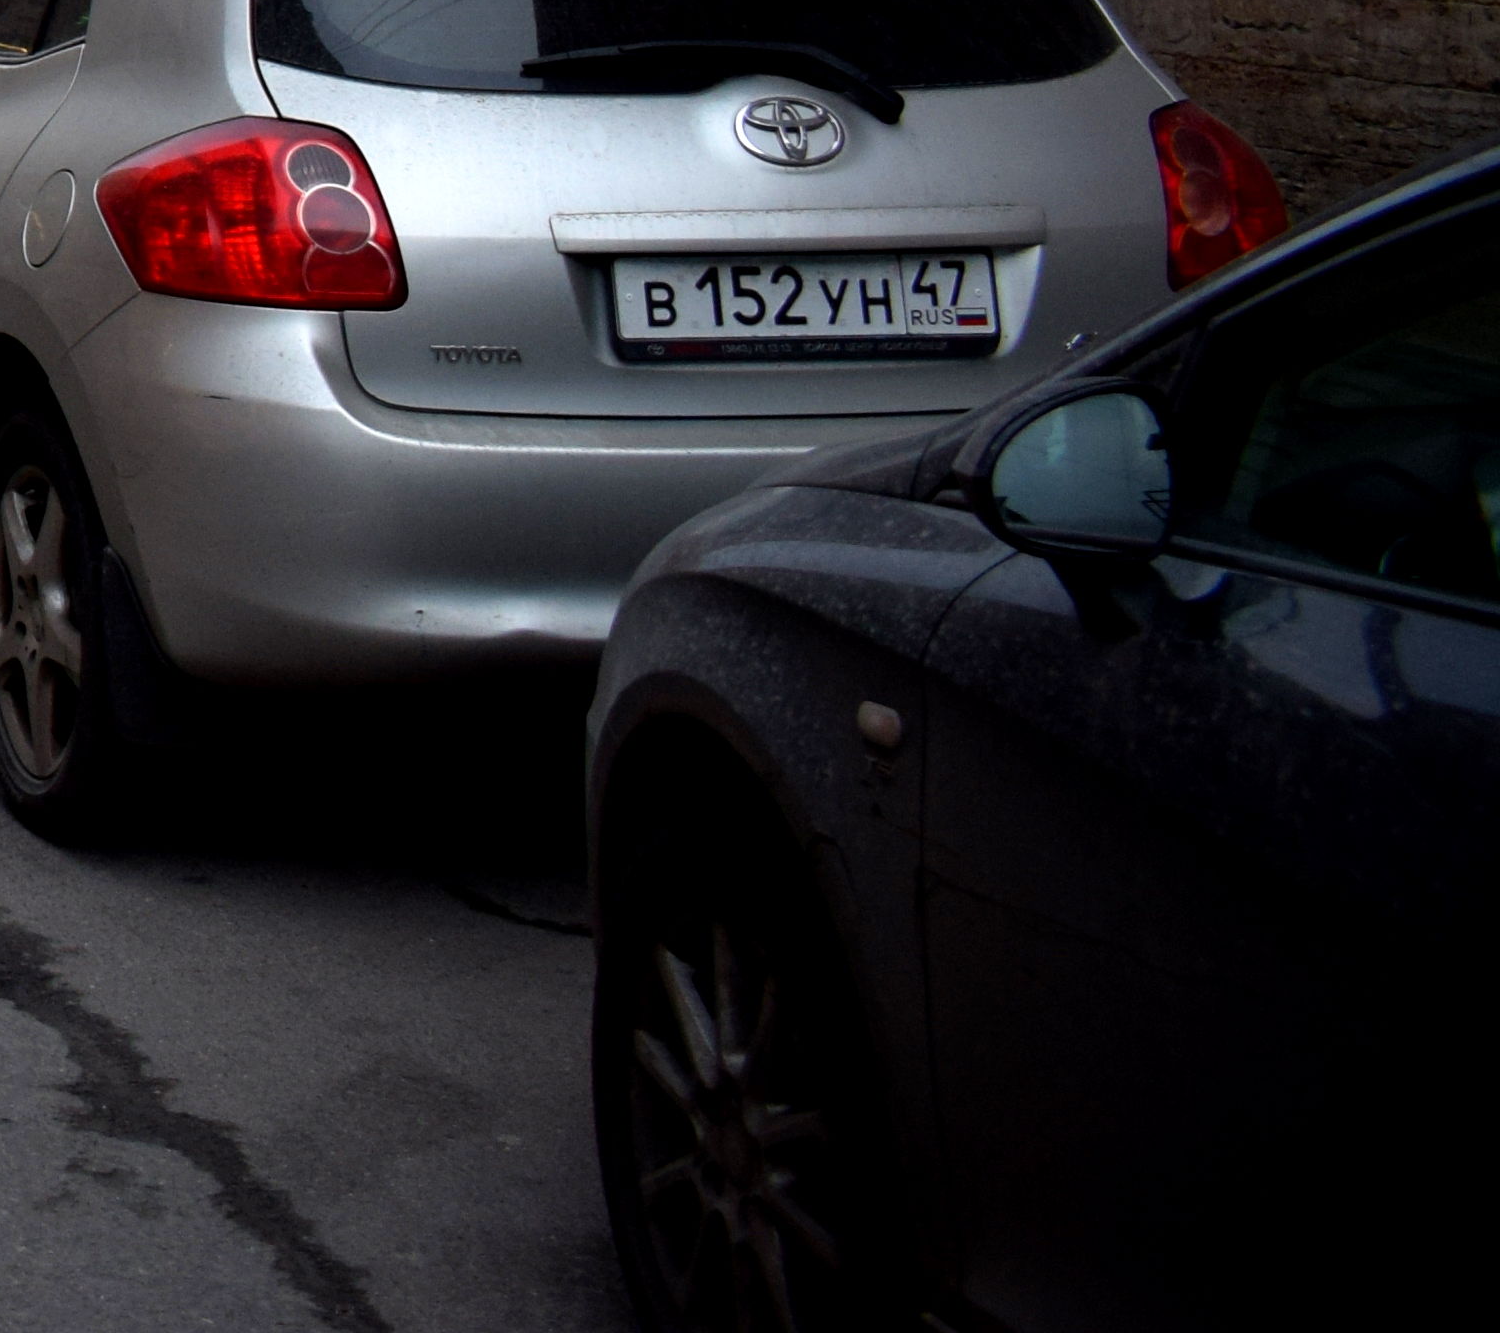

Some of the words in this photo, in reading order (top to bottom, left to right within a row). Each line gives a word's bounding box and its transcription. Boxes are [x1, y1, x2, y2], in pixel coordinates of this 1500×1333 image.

[911, 261, 966, 307] 47
[911, 308, 955, 326] RUS
[430, 345, 522, 364] TOYOTA
